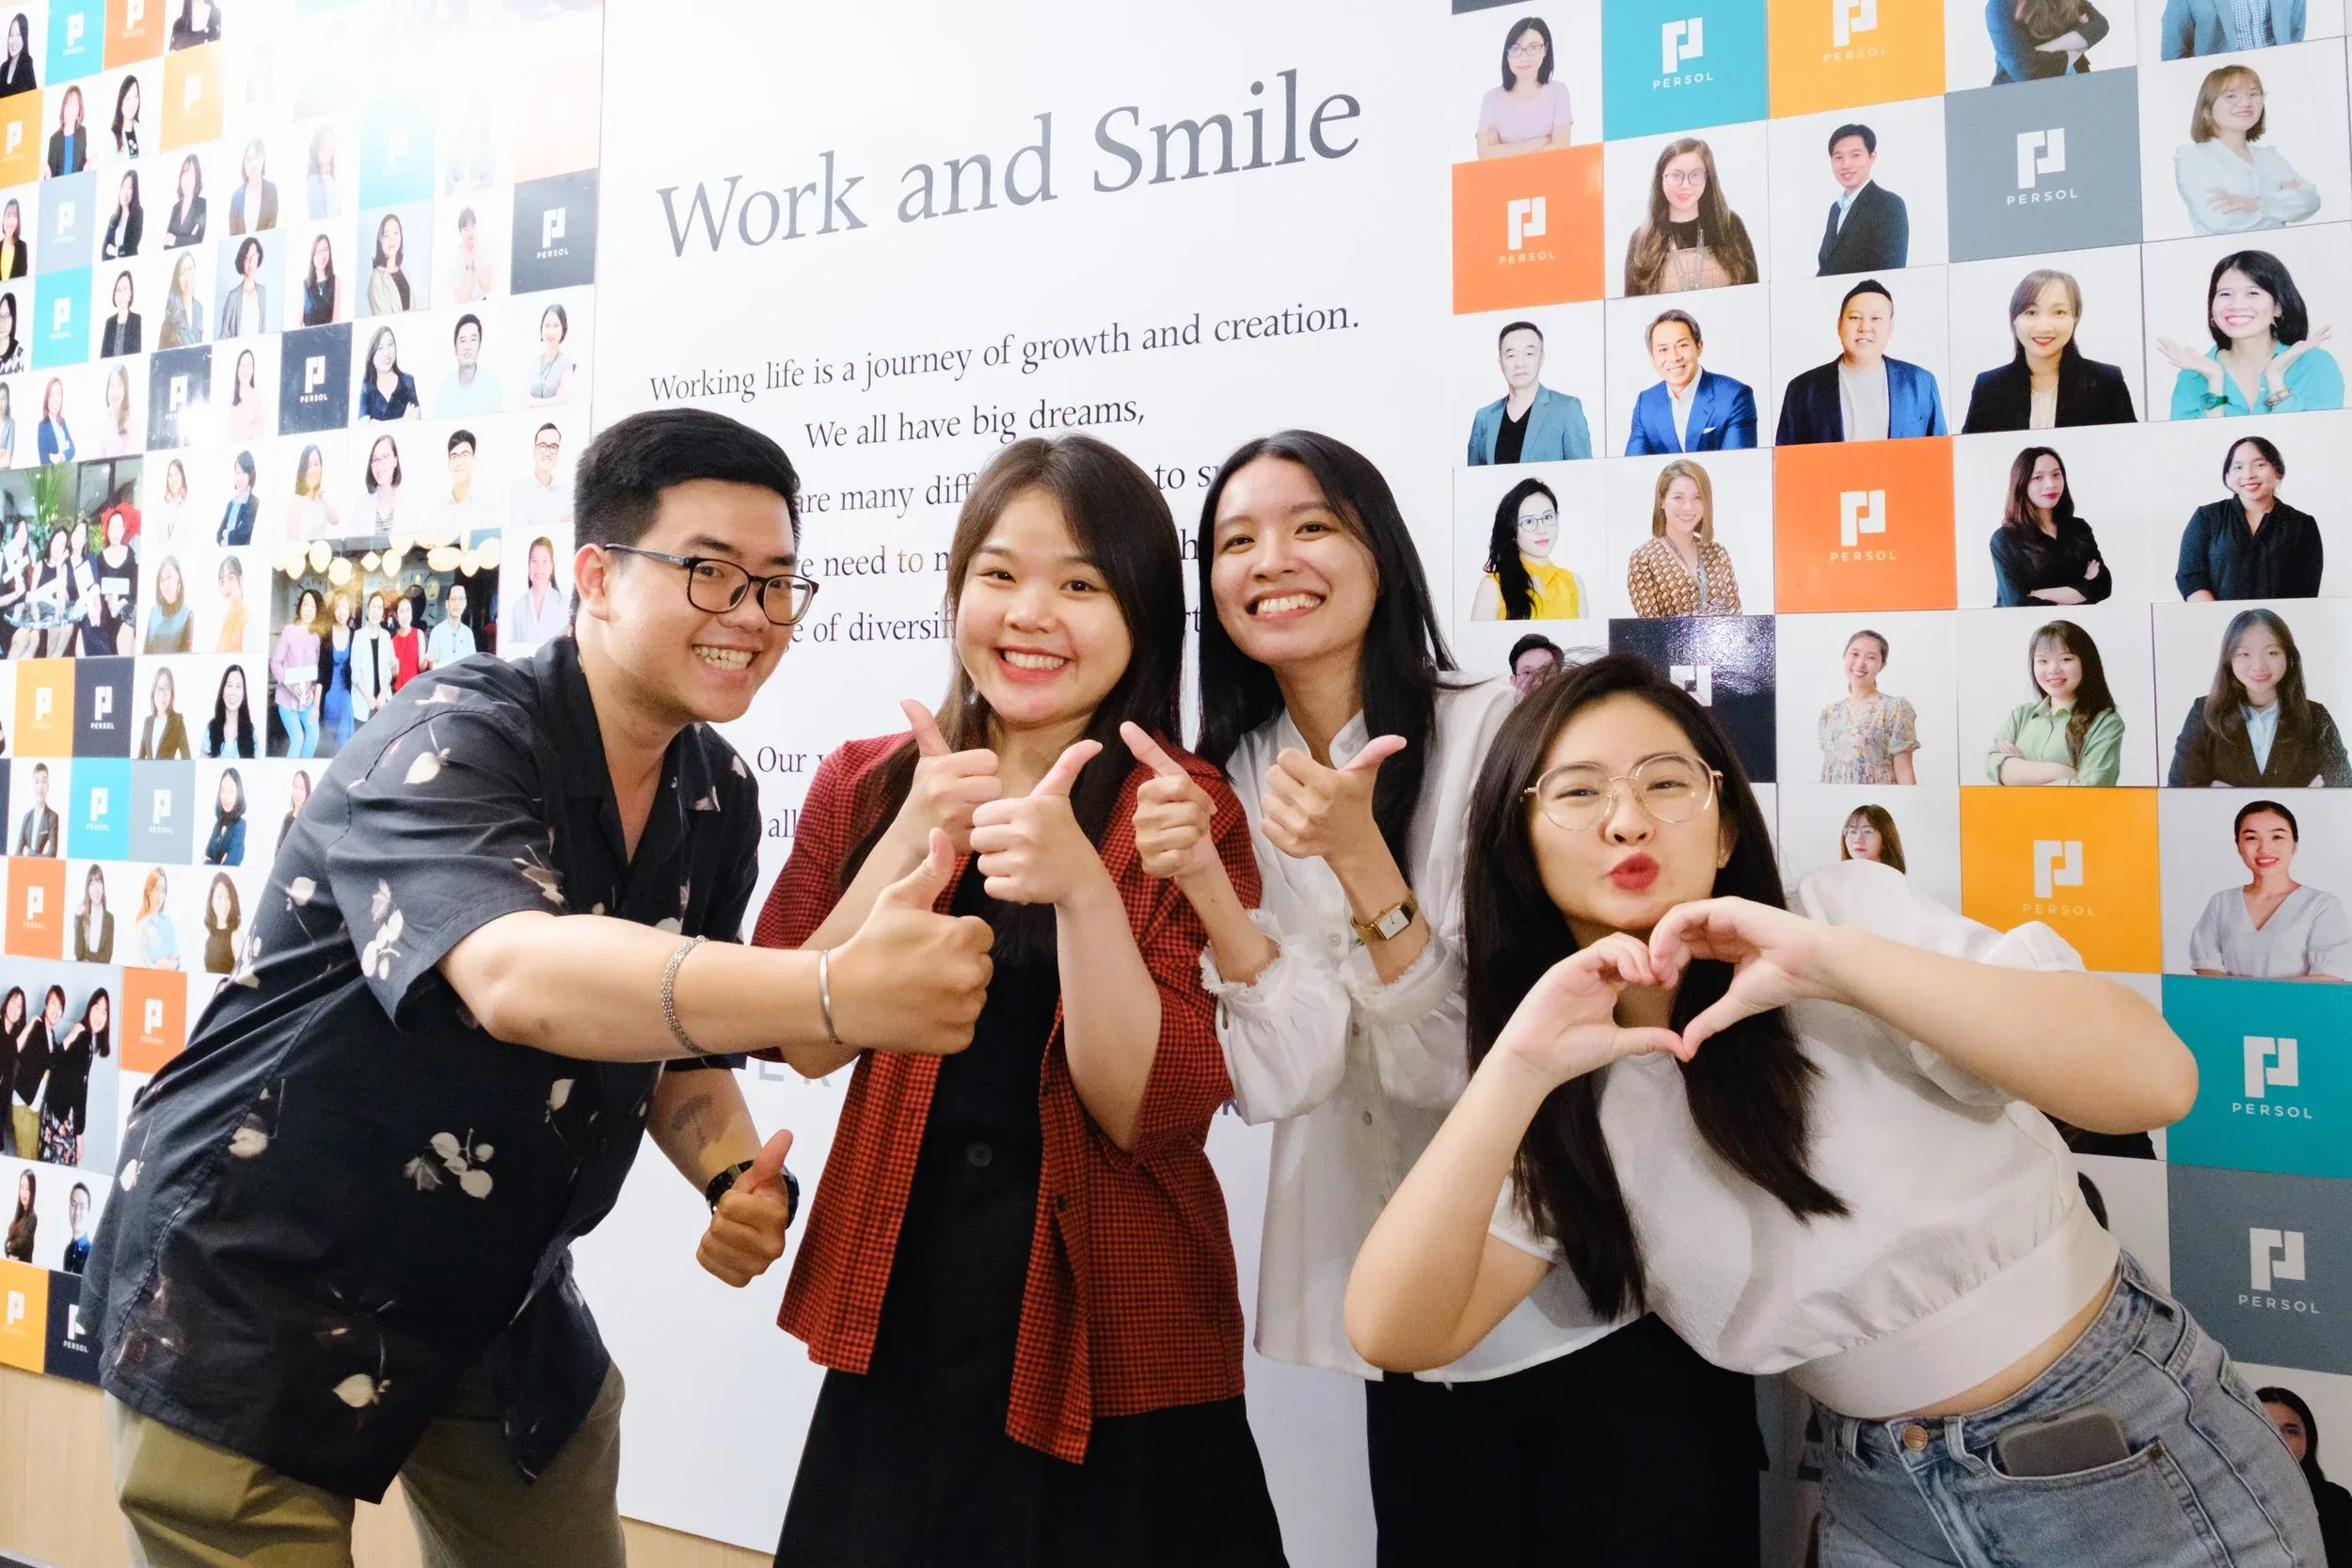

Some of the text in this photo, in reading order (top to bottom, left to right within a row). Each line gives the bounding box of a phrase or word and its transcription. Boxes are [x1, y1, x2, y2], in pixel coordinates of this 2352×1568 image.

[1822, 45, 1888, 62] PERSOL
[1652, 71, 1714, 89] PERSOL
[655, 68, 1361, 258] Work and Smile
[2006, 188, 2079, 206] PERSOL
[536, 248, 569, 260] PERSOL
[1498, 249, 1556, 265] PERSOL
[649, 303, 1359, 404] Working life is a journey of growth and creation.
[299, 394, 328, 404] PERSOL
[804, 398, 1145, 450] We all have big dreams,
[838, 486, 914, 519] many
[925, 471, 977, 505] diff
[1153, 464, 1185, 490] to
[822, 545, 887, 578] need
[897, 549, 924, 574] to
[1830, 549, 1898, 563] PERSOL
[813, 612, 842, 643] of
[756, 745, 807, 773] Our
[2022, 902, 2097, 917] PERSOL
[2231, 1101, 2313, 1120] PERSOL
[2237, 1292, 2321, 1315] PERSOL
